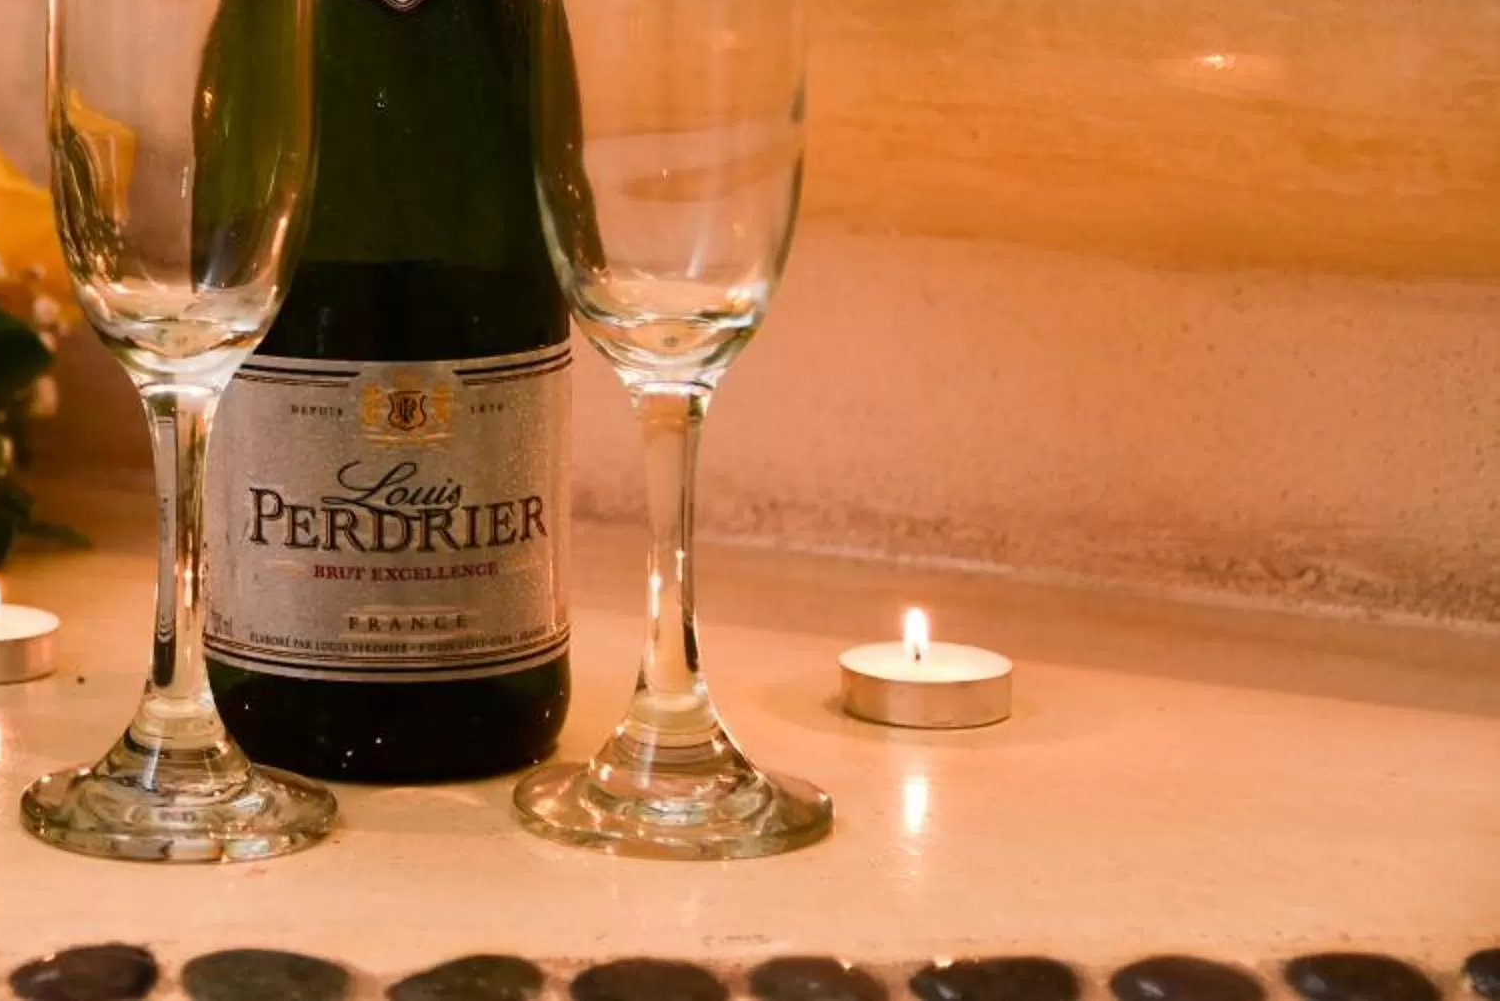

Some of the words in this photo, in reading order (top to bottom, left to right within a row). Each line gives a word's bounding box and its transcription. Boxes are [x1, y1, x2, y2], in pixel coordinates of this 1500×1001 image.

[320, 460, 461, 521] Louis
[248, 486, 548, 553] PERDRIER
[313, 564, 367, 581] BRUT
[371, 561, 499, 582] EXCELLENCE
[349, 615, 468, 632] FRANCE
